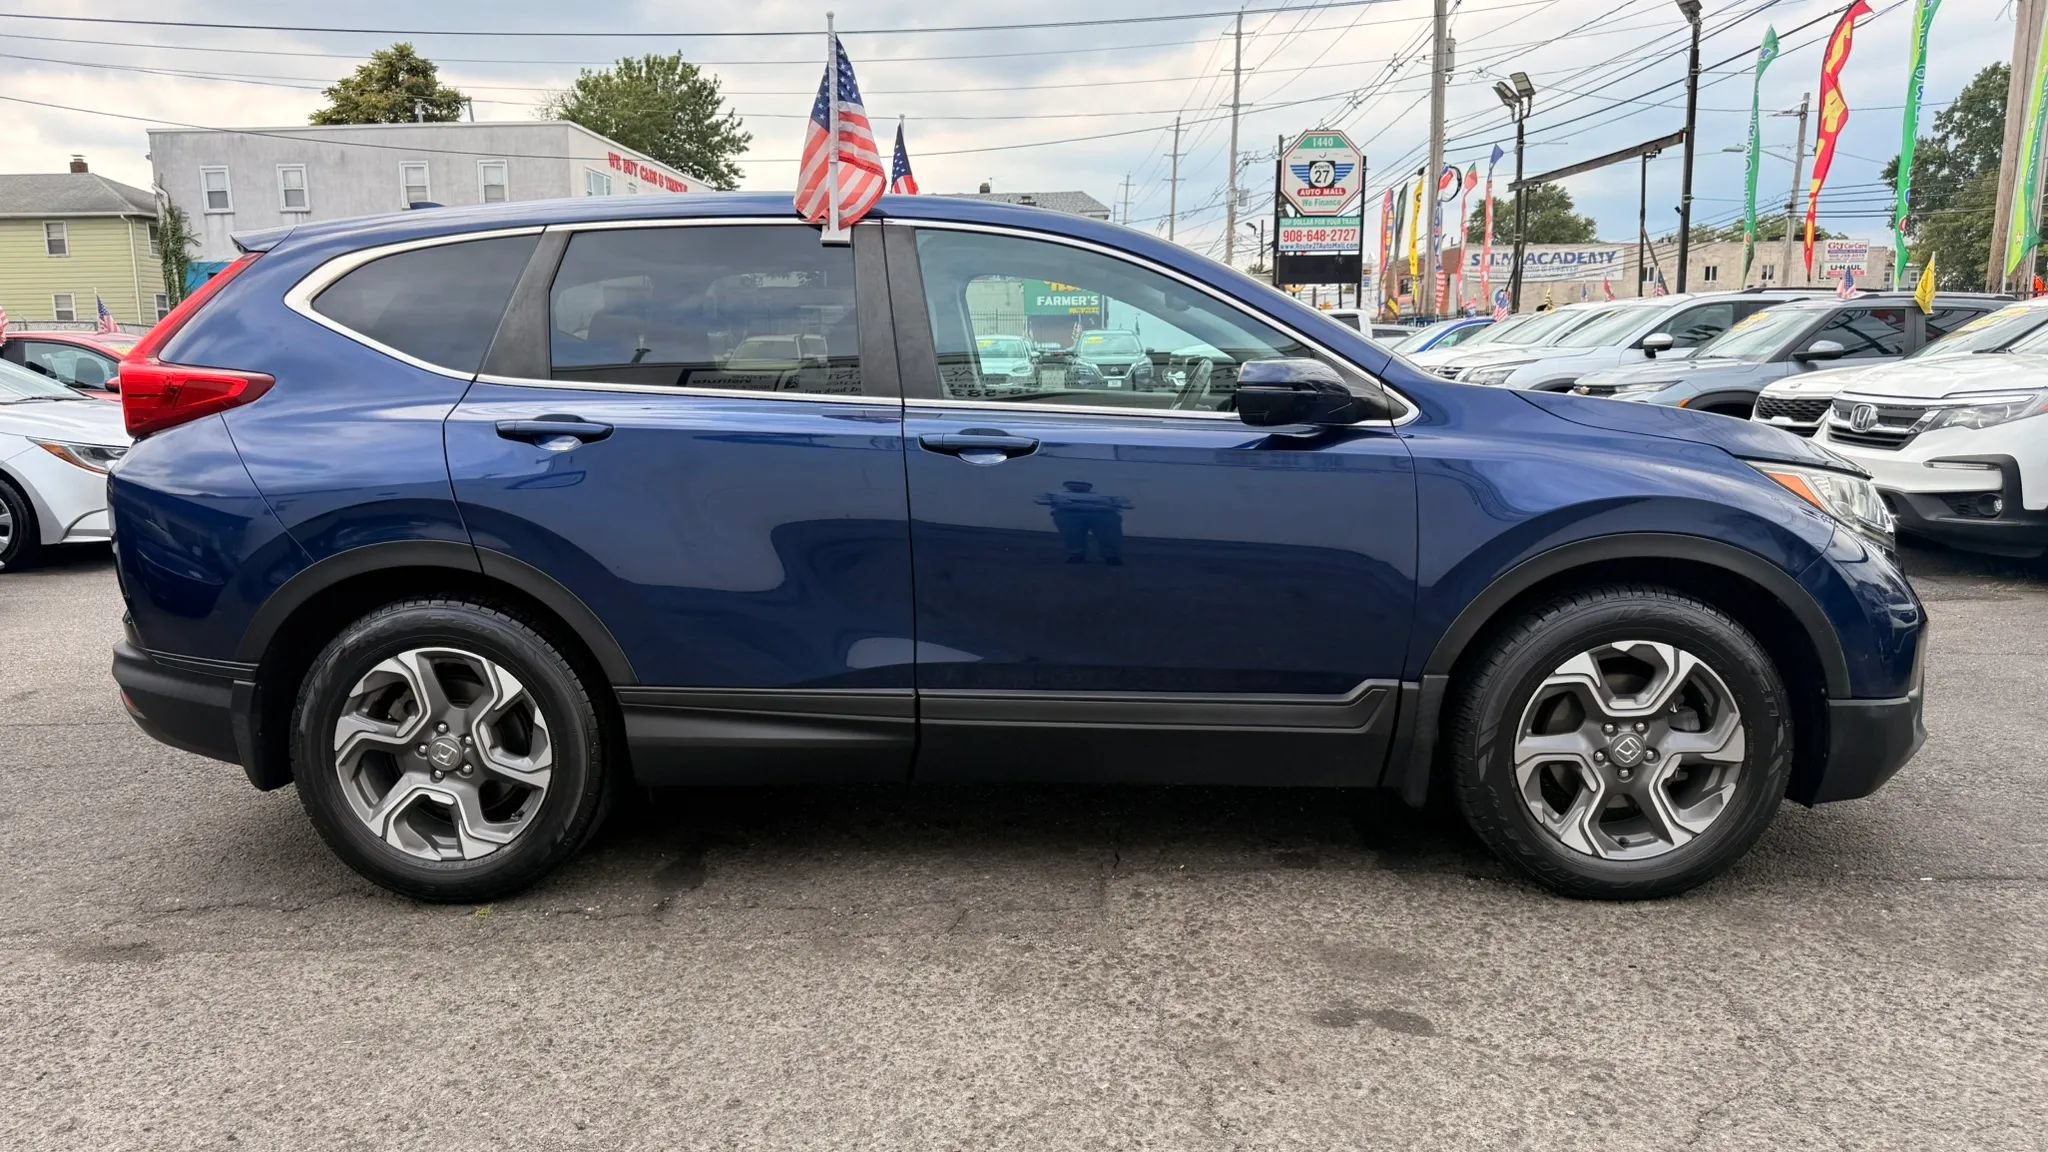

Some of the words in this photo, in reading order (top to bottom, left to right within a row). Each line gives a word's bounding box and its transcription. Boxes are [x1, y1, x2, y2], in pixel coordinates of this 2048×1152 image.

[1312, 137, 1334, 148] 1440
[608, 152, 621, 171] WE
[623, 158, 638, 177] BUY
[640, 166, 657, 185] CARS
[1314, 170, 1330, 183] 27
[1322, 188, 1344, 196] MALL
[1314, 199, 1342, 207] Finance
[1283, 229, 1357, 243] 908-648-2727
[1036, 295, 1099, 307] FARMER'S
